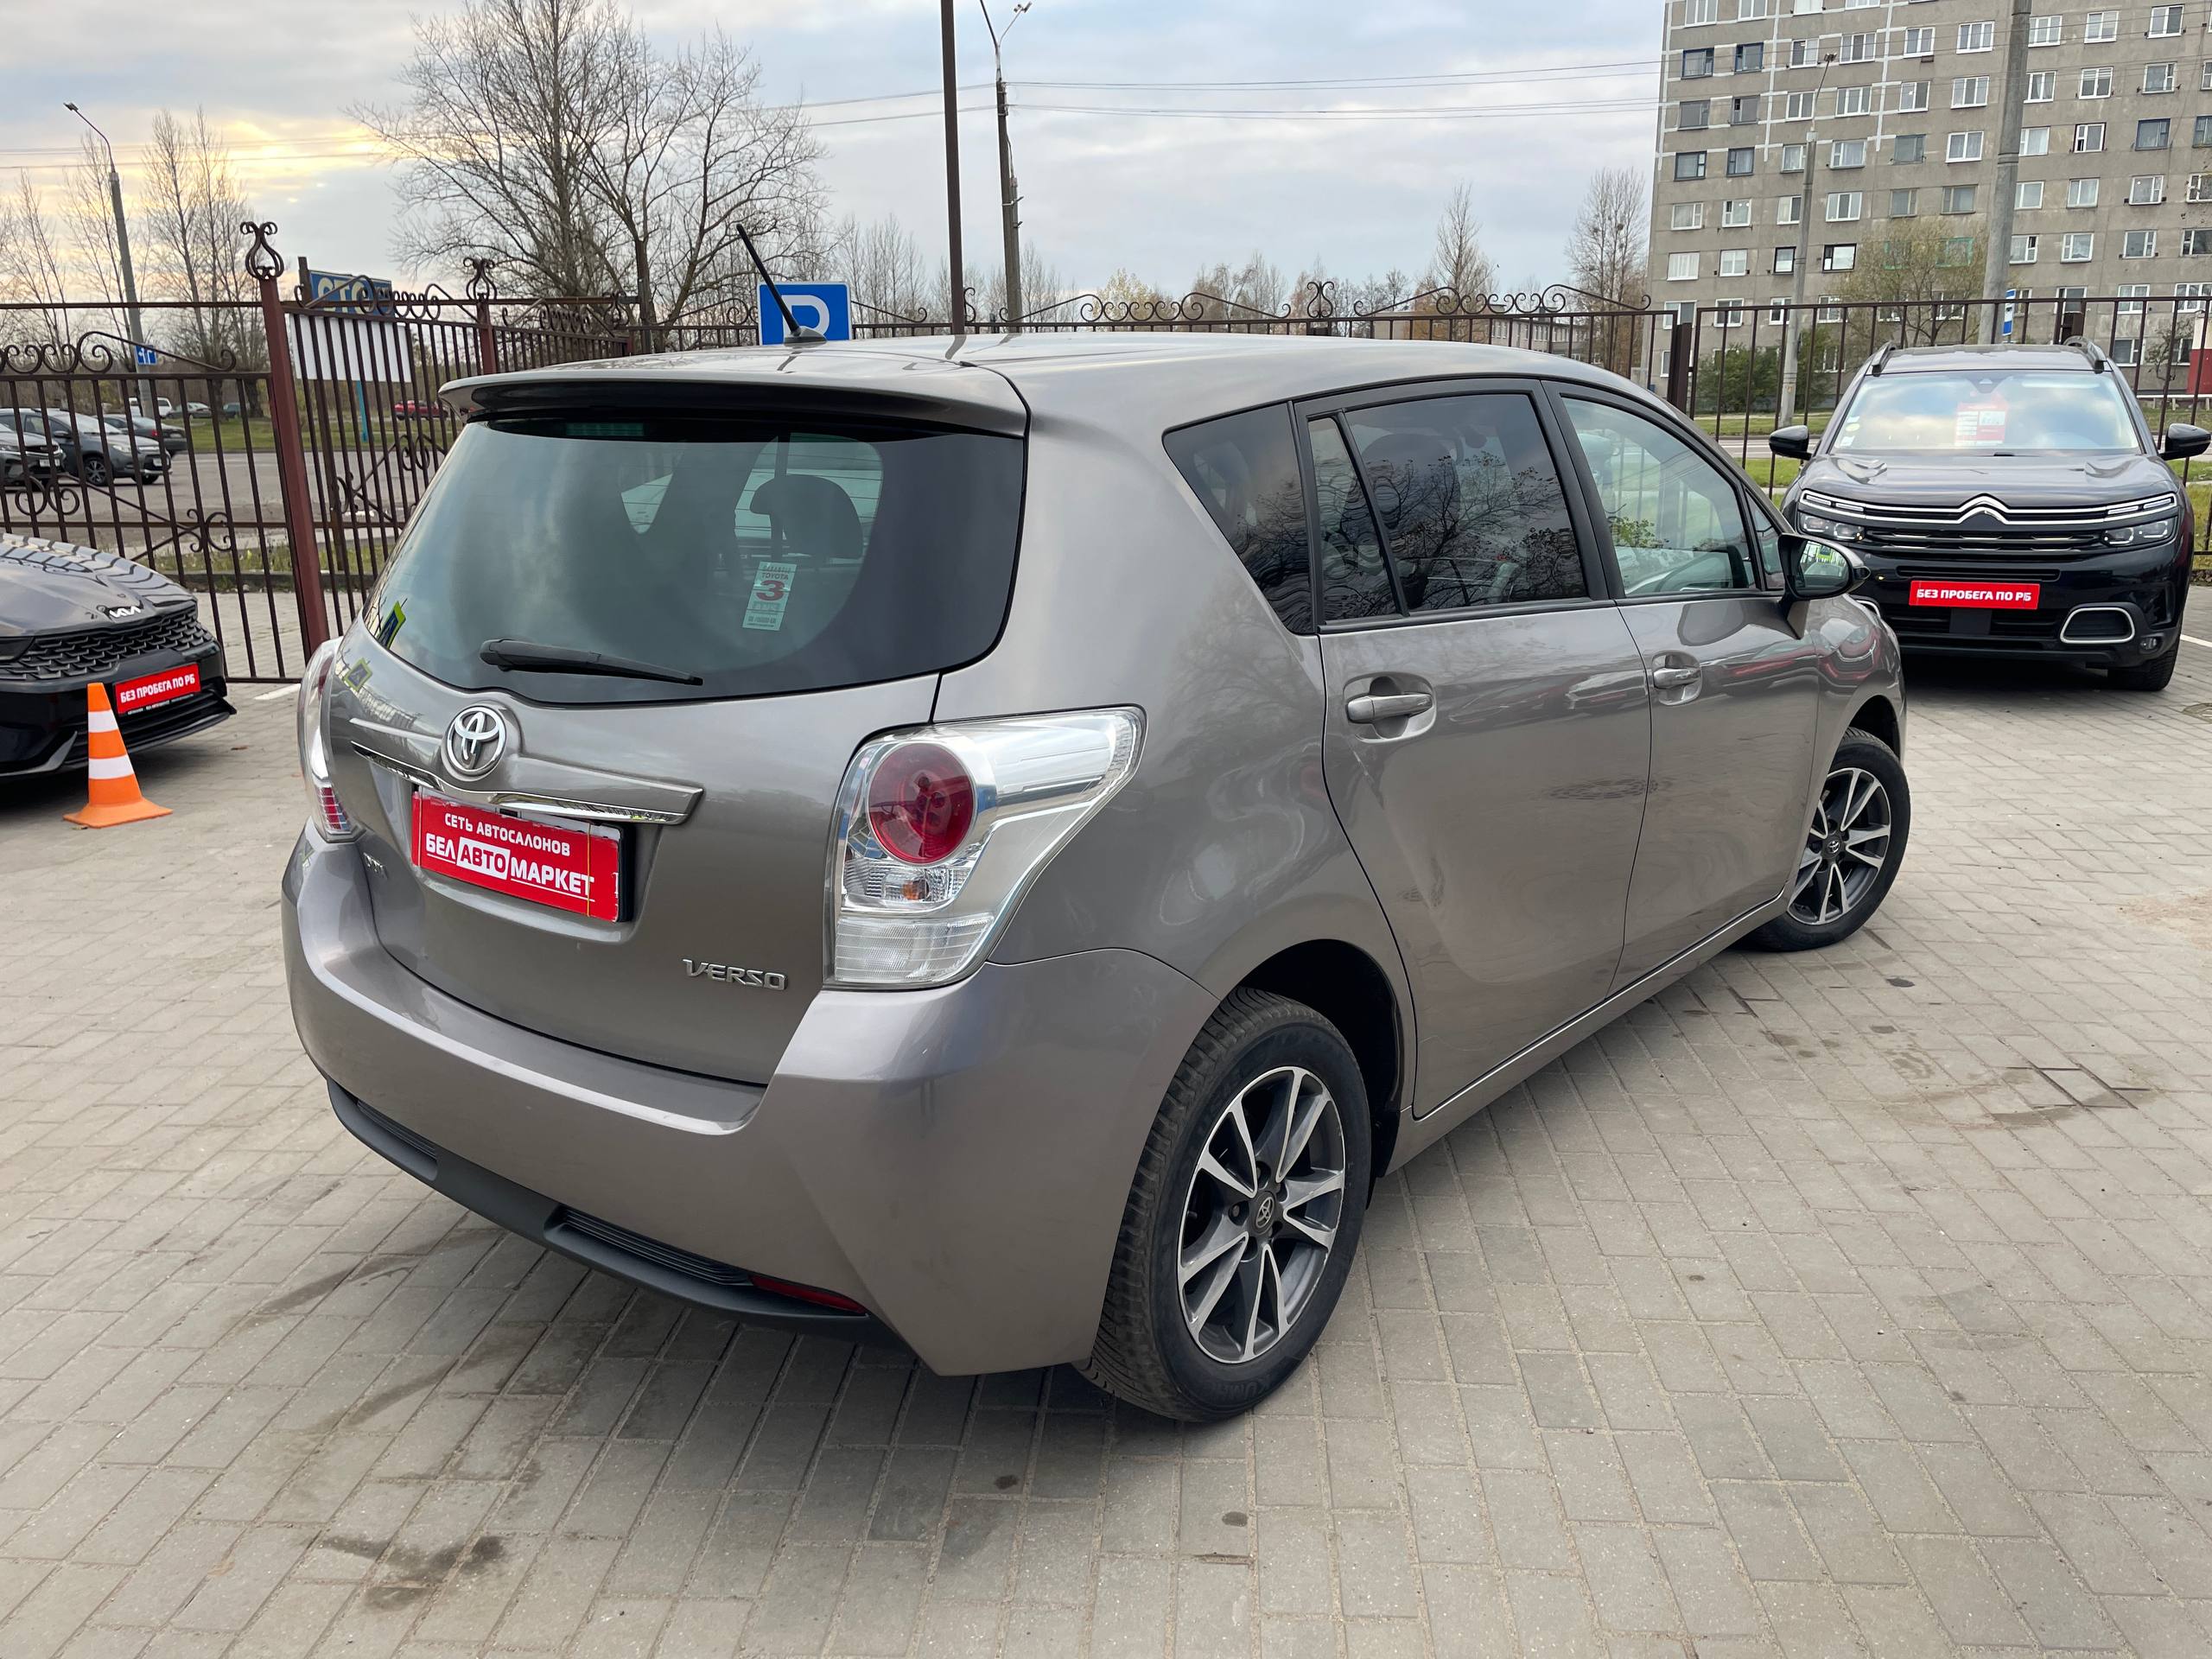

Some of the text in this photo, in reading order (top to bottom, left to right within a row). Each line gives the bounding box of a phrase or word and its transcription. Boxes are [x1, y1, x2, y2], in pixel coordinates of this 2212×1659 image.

[755, 580, 785, 601] 3
[1916, 589, 2031, 602] БЕЗ ПРОБЕГА ПО РБ
[120, 673, 195, 703] БЕЗ ПРОБЕГА ПО РБ
[444, 813, 570, 856] СЕТЬ АВТОСАЛОНОВ
[683, 958, 785, 990] VERSO
